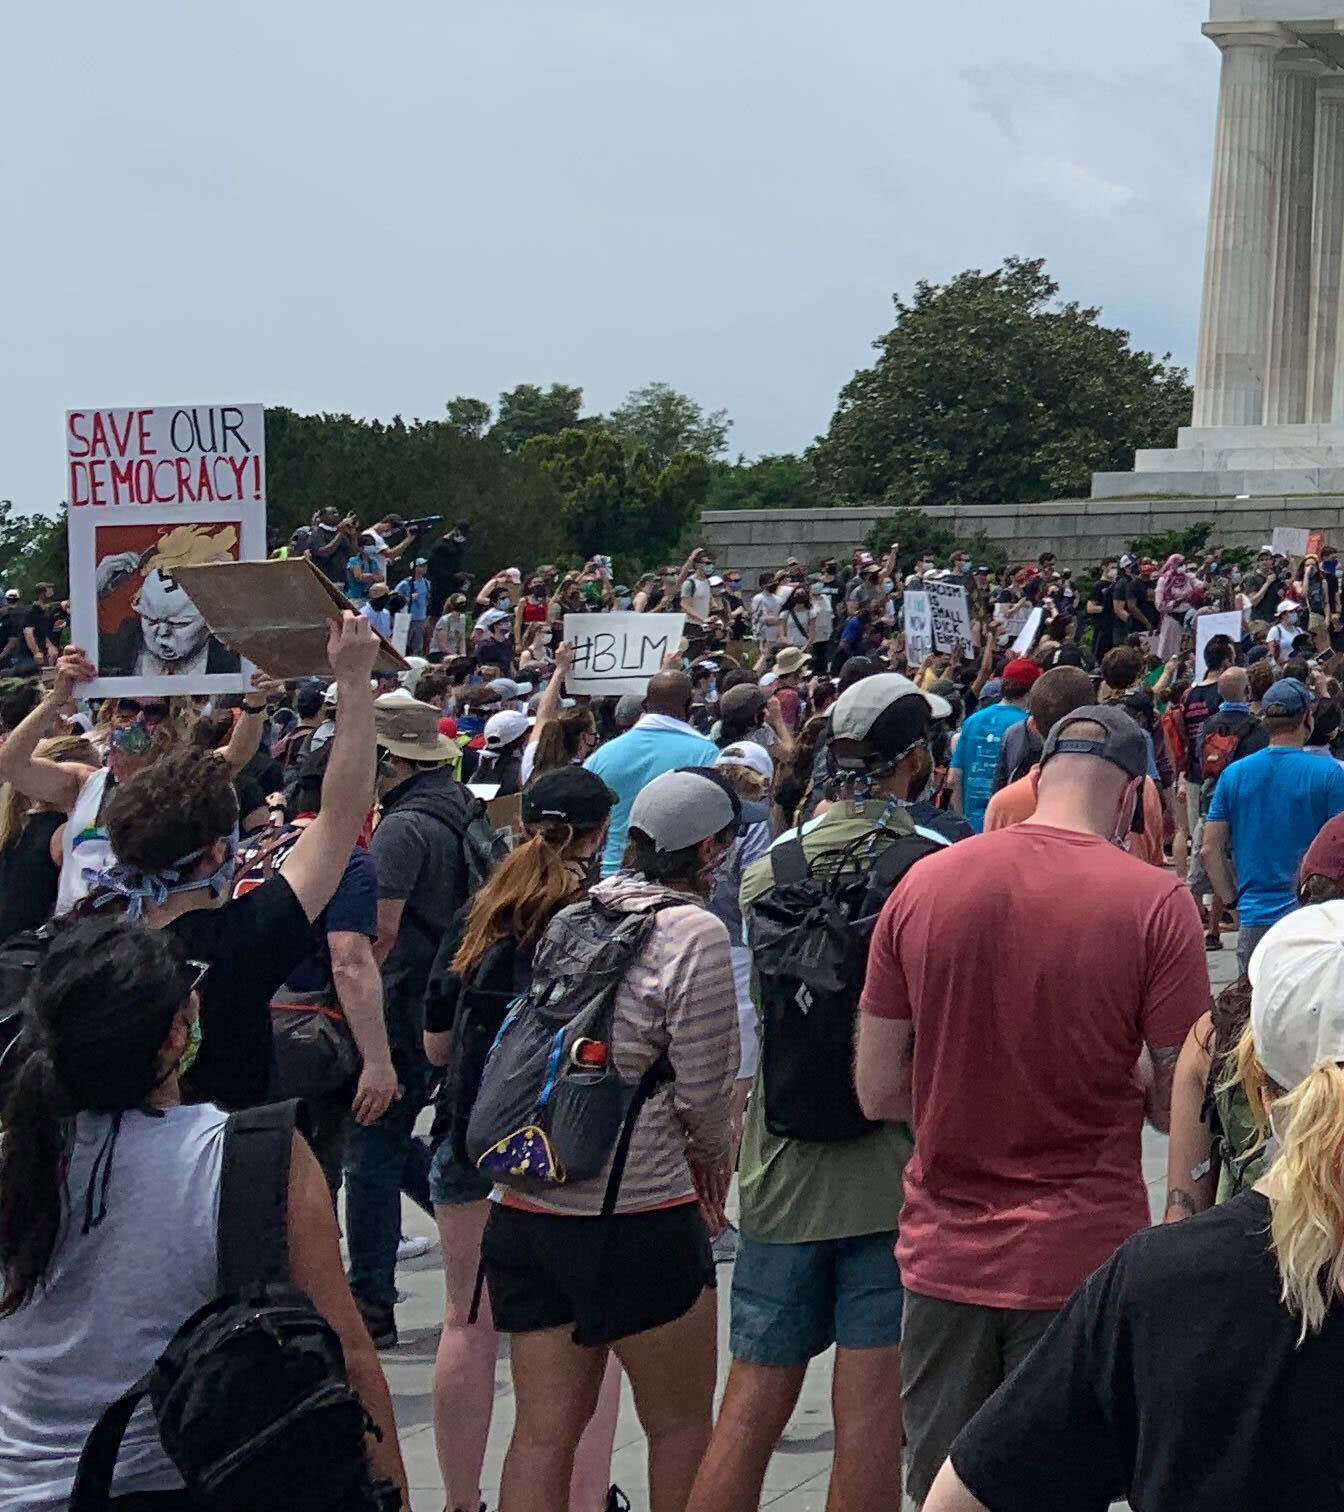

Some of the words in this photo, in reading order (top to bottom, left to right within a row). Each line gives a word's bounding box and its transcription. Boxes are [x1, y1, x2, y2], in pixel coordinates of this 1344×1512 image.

[68, 409, 157, 458] SAVE
[170, 407, 251, 454] OUR
[69, 455, 262, 507] DEMOCRACY!
[570, 632, 668, 673] #BLM
